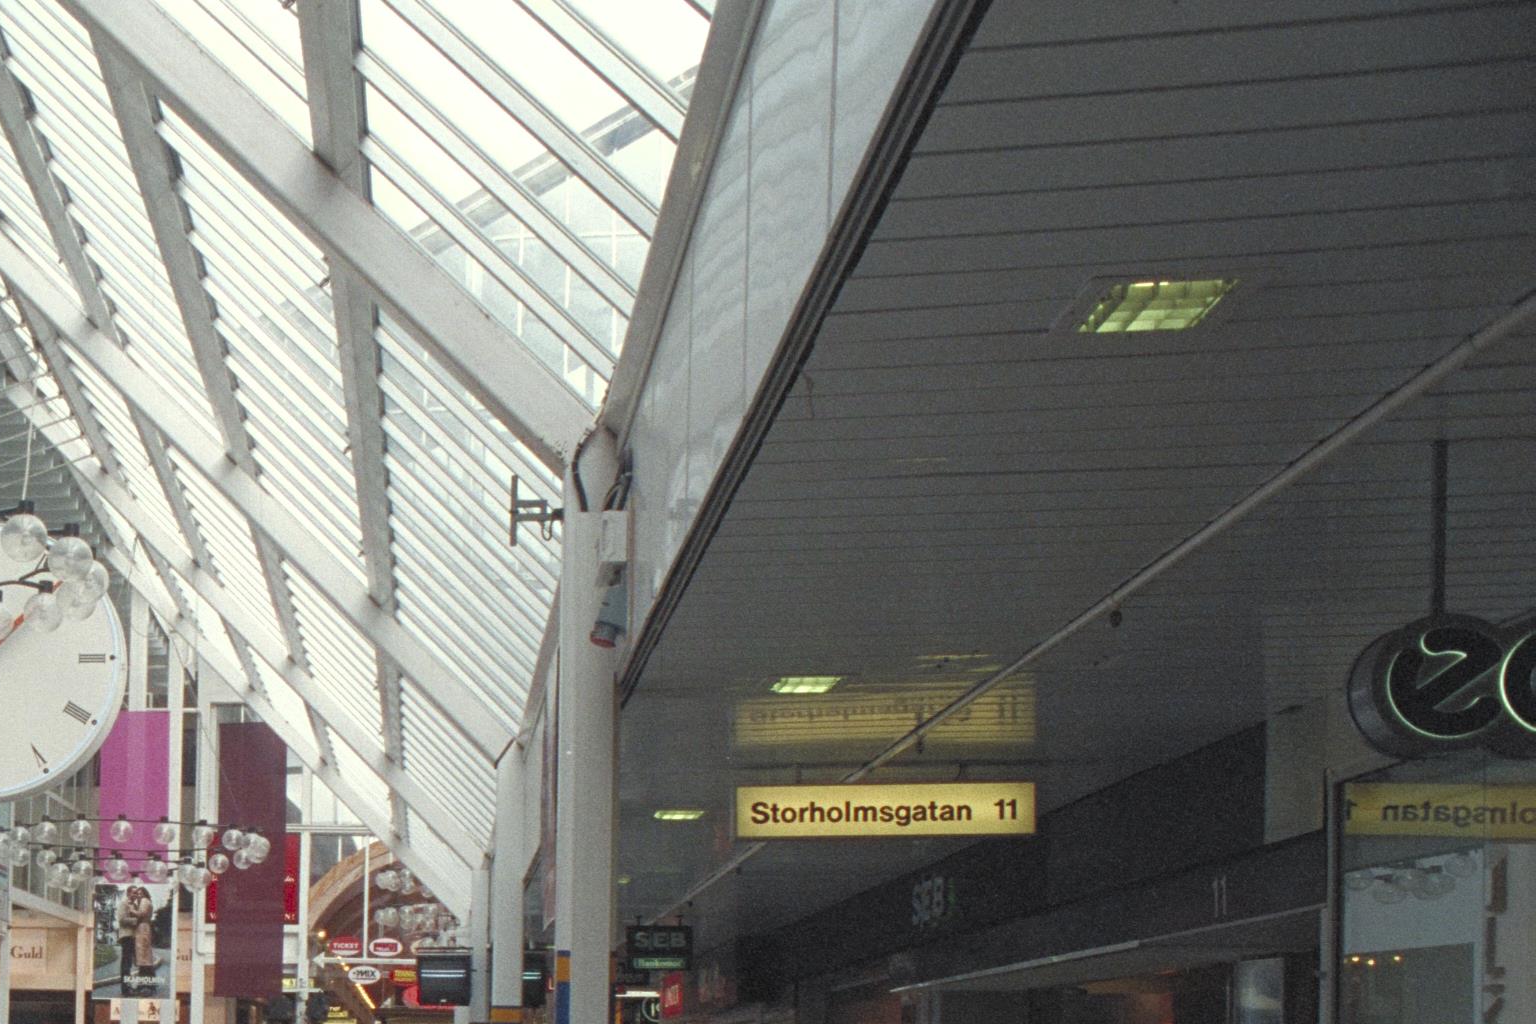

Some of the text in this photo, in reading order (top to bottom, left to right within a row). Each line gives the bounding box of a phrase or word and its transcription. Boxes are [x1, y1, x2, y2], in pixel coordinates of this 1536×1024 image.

[750, 799, 1018, 827] Storholmsgatan 11
[634, 931, 687, 948] SEB
[11, 946, 43, 960] Guld
